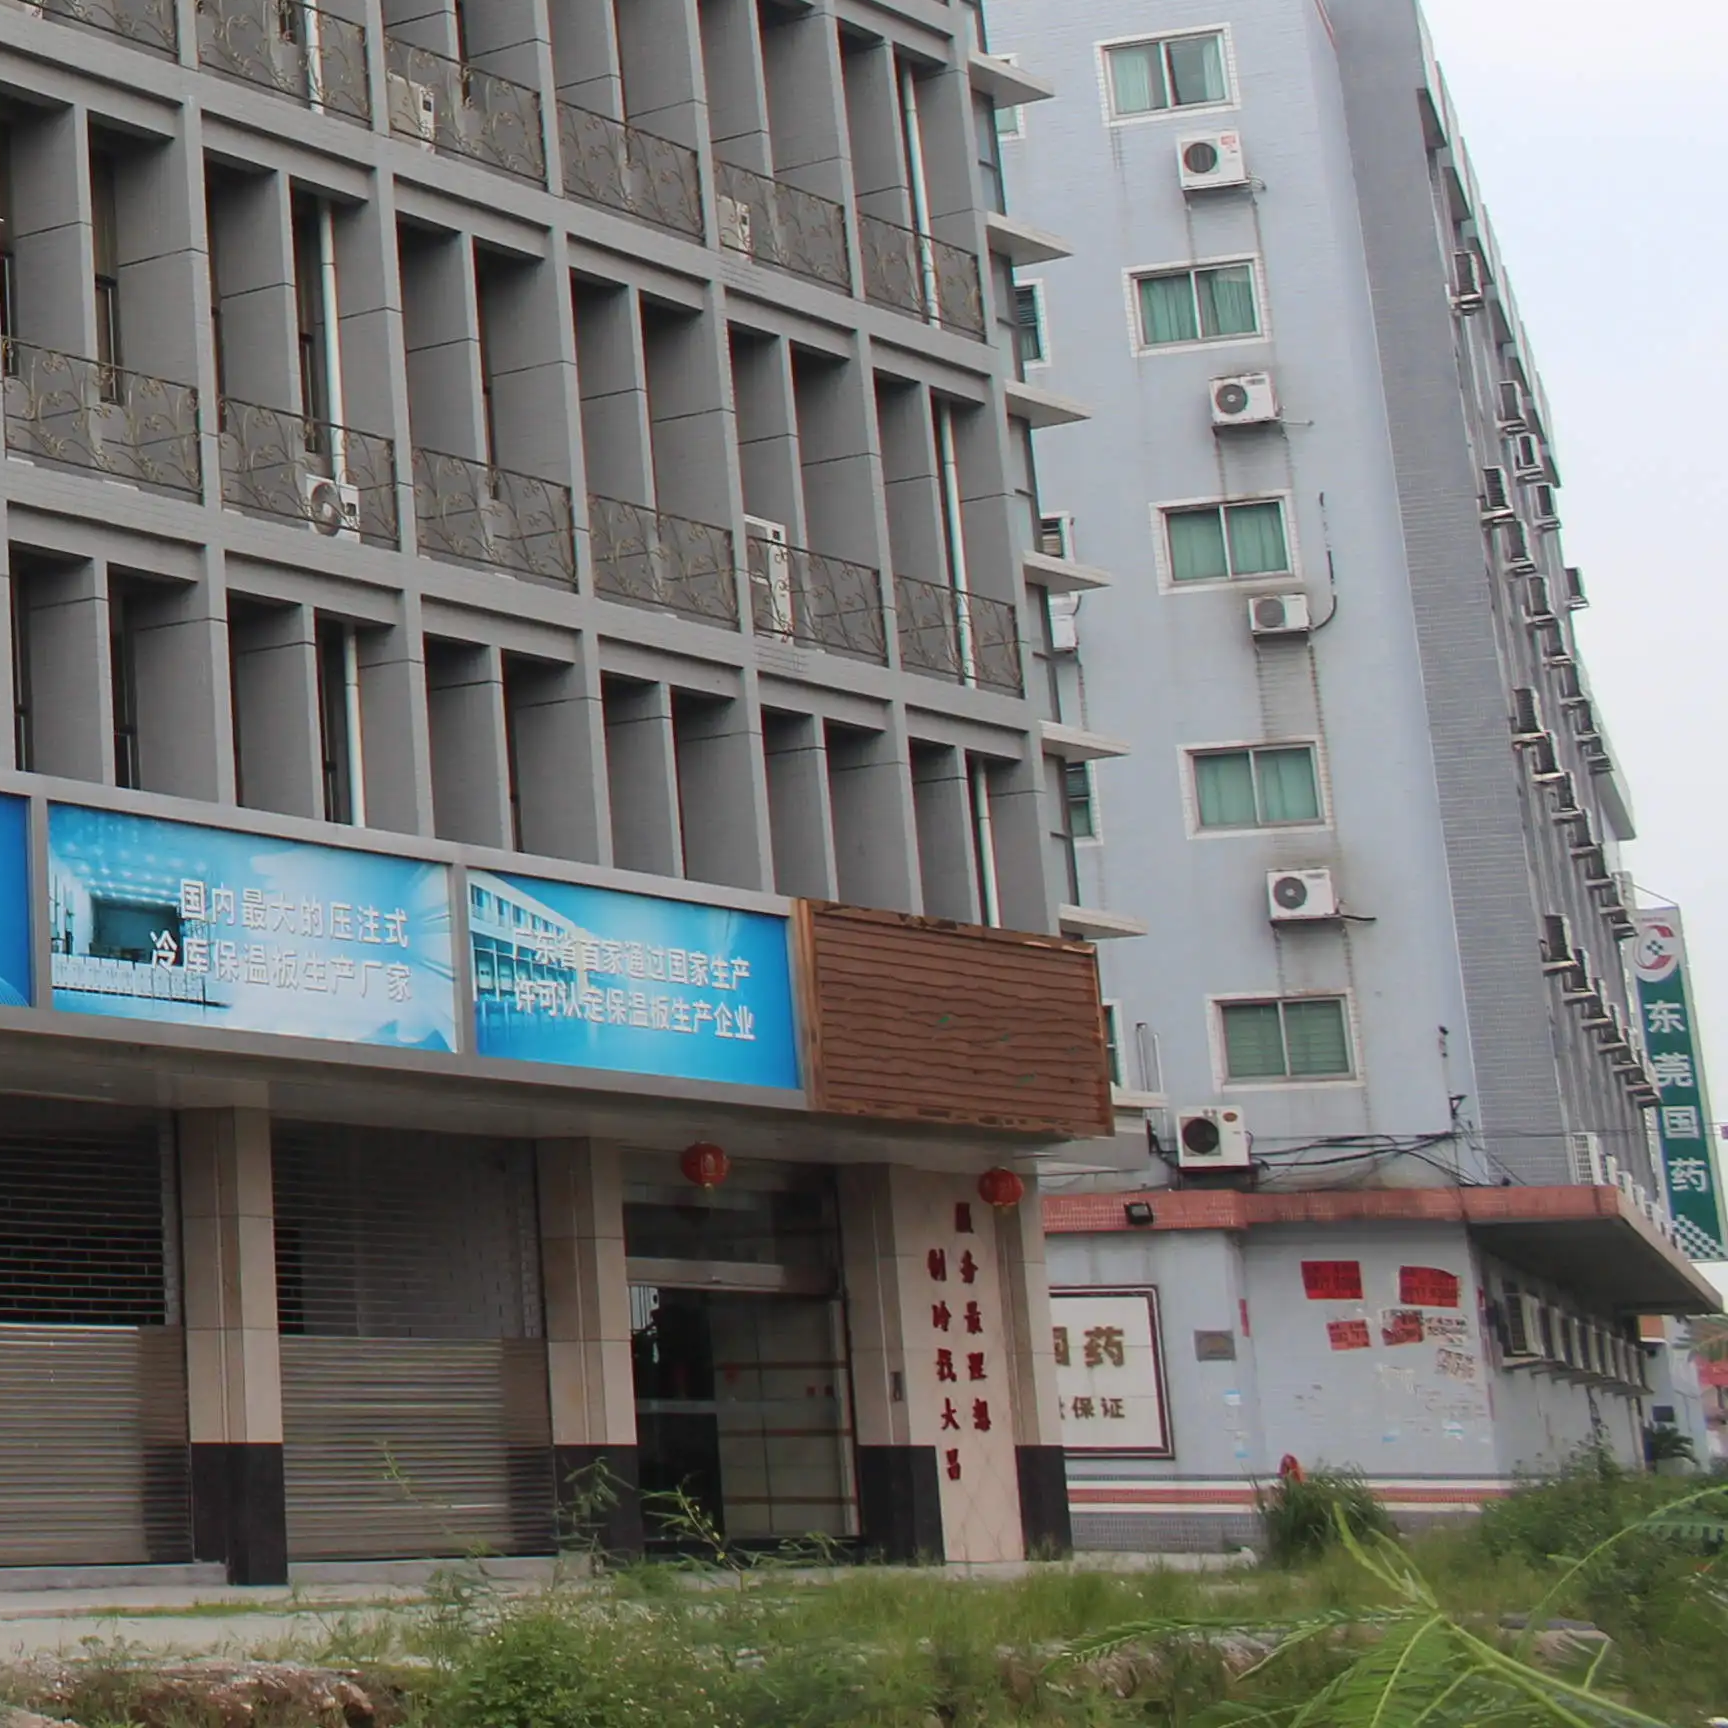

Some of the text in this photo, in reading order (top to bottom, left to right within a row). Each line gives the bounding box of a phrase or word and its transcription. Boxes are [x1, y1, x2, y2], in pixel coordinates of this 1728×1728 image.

[180, 878, 409, 948] 国内最大的压注式
[149, 929, 412, 1002] 冷库保温板生产厂家
[515, 973, 756, 1040] 许可认定保温板生产企业
[1645, 1000, 1709, 1193] 东莞国药
[1058, 1396, 1125, 1420] 保证
